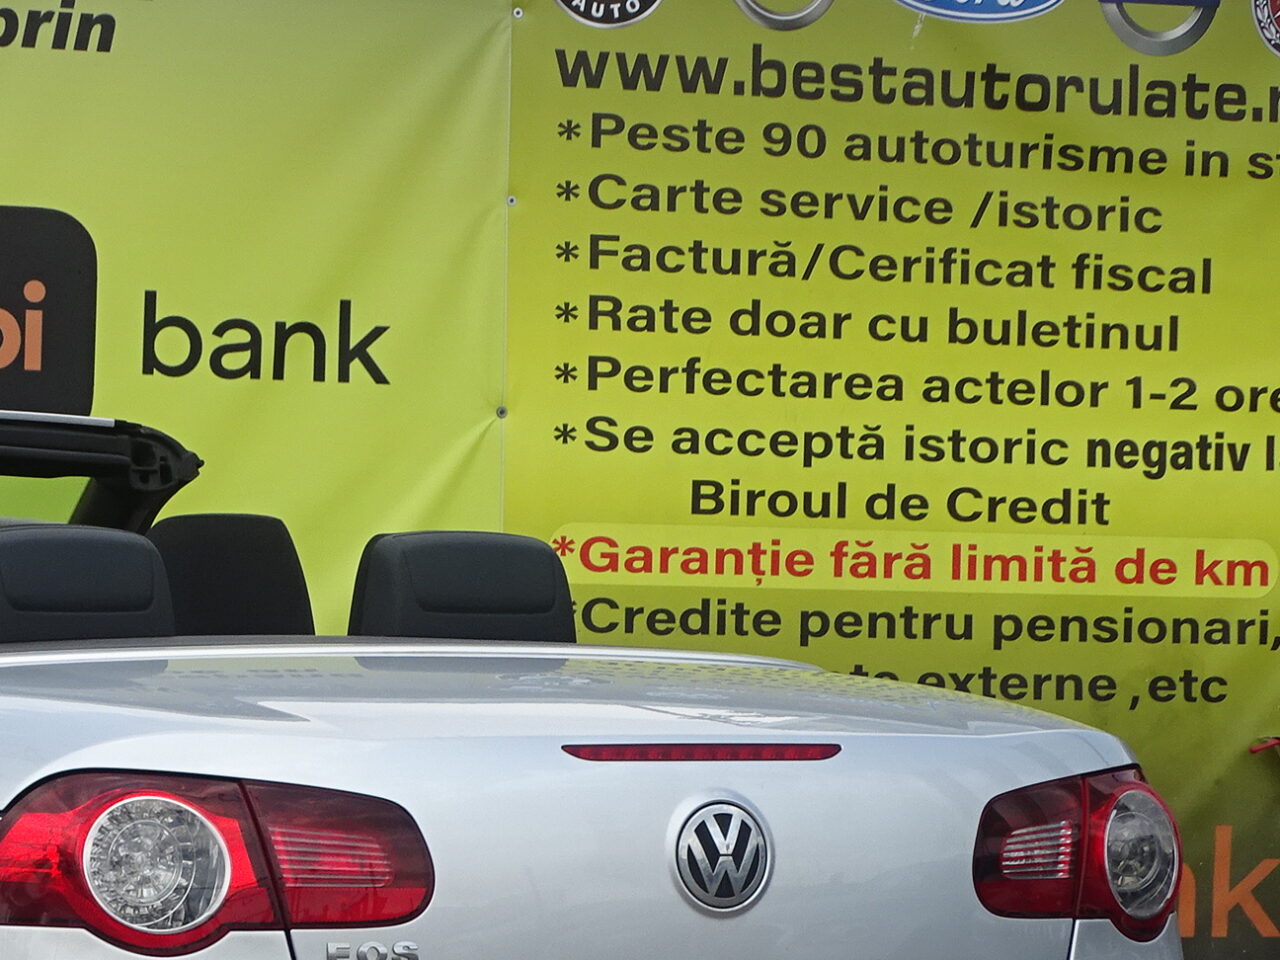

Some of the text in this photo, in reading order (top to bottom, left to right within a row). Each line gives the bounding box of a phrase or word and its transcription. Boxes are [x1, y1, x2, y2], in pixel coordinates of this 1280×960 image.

[763, 124, 827, 160] 90
[844, 131, 1167, 176] autoturisme
[1185, 141, 1229, 177] in
[1247, 152, 1280, 180] s
[760, 184, 953, 224] service
[970, 190, 1163, 234] /istoric
[1072, 252, 1212, 294] fiscal
[142, 290, 391, 385] bank
[729, 299, 853, 339] doar
[867, 311, 929, 343] cu
[947, 306, 1179, 352] buletinul
[920, 370, 1109, 408] actelor
[1126, 375, 1198, 411] 1-2
[671, 423, 886, 467] acceptă
[903, 425, 1069, 467] istoric
[1086, 431, 1250, 479] negativ
[690, 479, 1111, 526] Biroul de Credit
[830, 540, 932, 579] fără
[950, 544, 1096, 583] limită
[1114, 548, 1178, 586] de
[1195, 550, 1270, 587] km
[799, 600, 974, 648] pentru
[992, 606, 1280, 652] pensionari,
[918, 666, 1118, 701] externe
